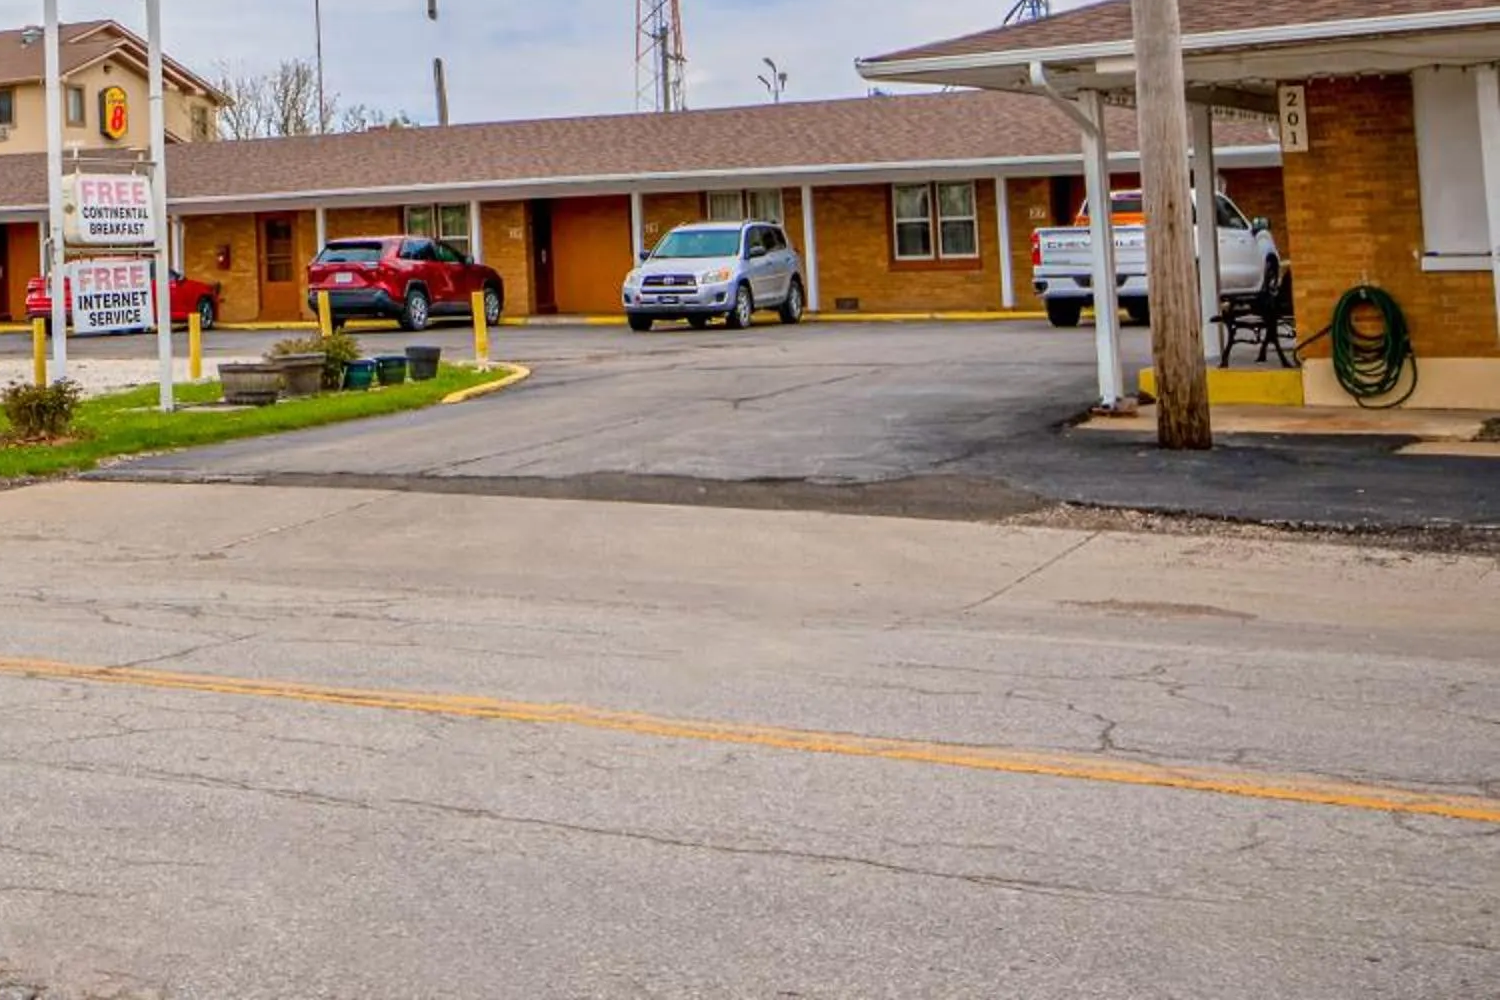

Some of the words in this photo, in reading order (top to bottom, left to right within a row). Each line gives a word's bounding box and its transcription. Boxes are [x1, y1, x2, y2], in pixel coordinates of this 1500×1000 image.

[112, 105, 124, 130] 8
[1286, 91, 1299, 145] 201
[80, 181, 147, 205] FREE
[81, 206, 149, 219] CONTINENTAL
[89, 222, 145, 235] BREAKFAST
[78, 265, 145, 292] FREE
[78, 291, 148, 310] INTERNET
[89, 308, 141, 327] SERVICE
